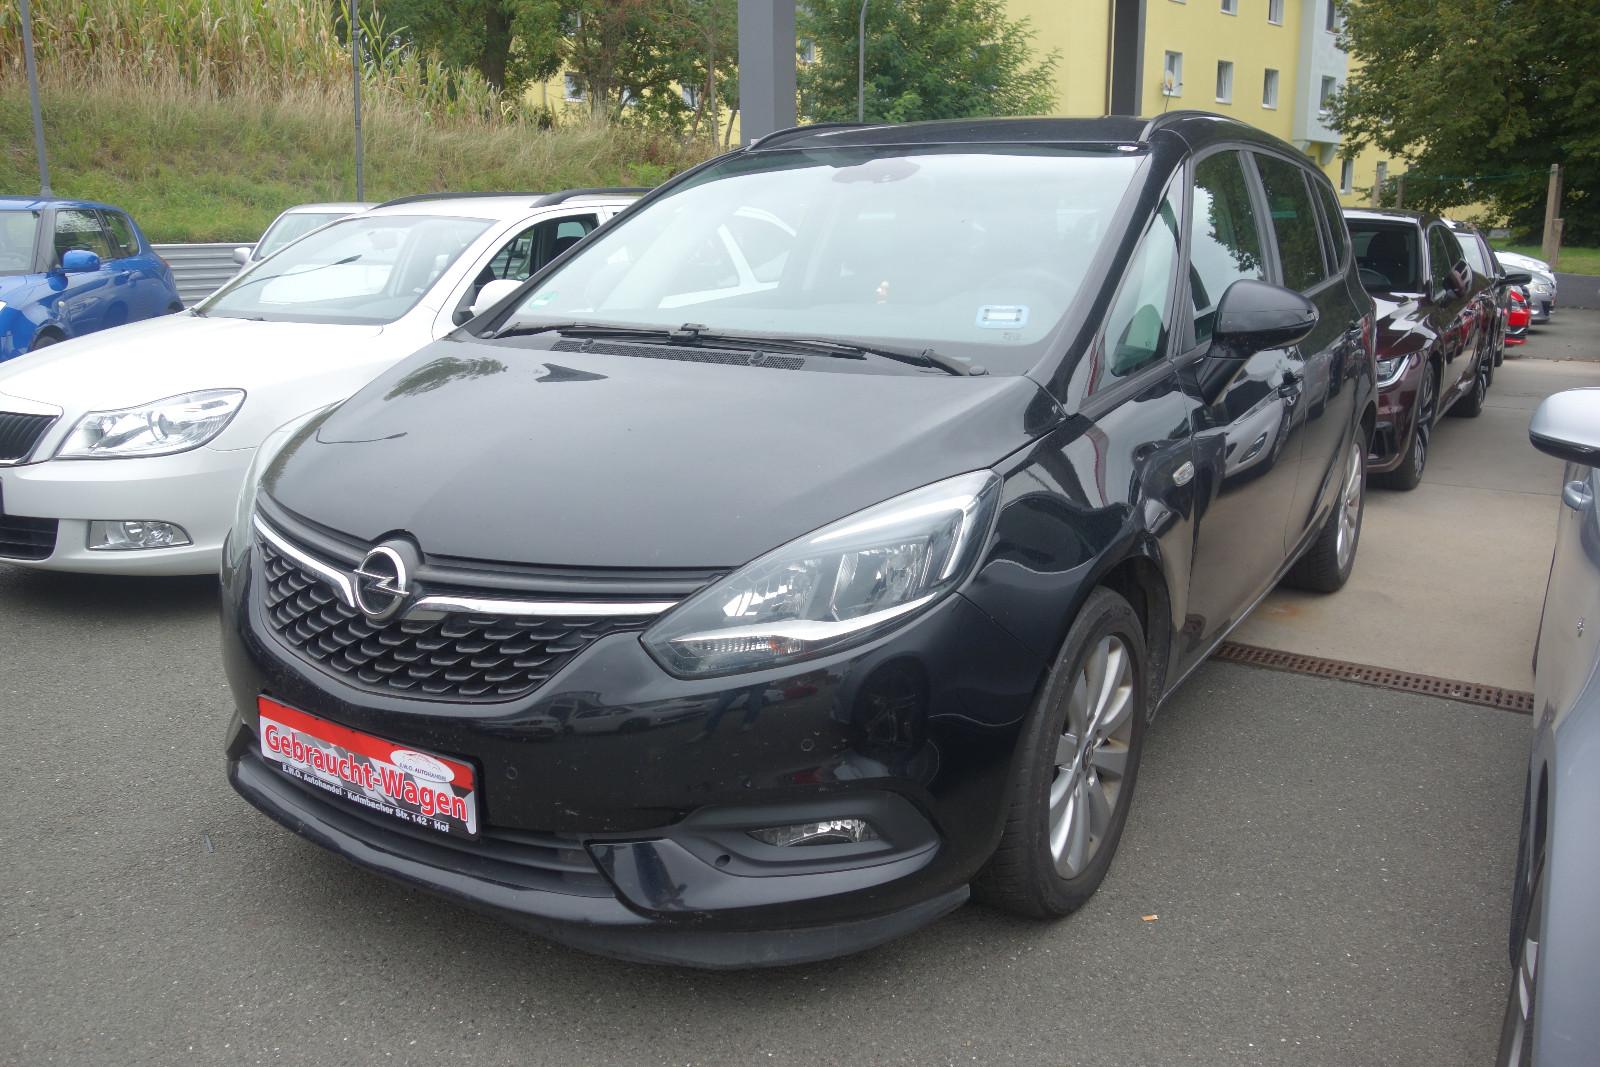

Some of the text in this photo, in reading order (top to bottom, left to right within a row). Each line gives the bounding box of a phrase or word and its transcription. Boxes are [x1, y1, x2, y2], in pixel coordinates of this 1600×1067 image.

[264, 724, 469, 822] Gebraucht-Wagen
[303, 773, 343, 797] Autohandel
[347, 791, 394, 815] Kulmbacher
[395, 807, 410, 821] Str.
[412, 813, 428, 826] 142
[433, 820, 450, 833] Hof
